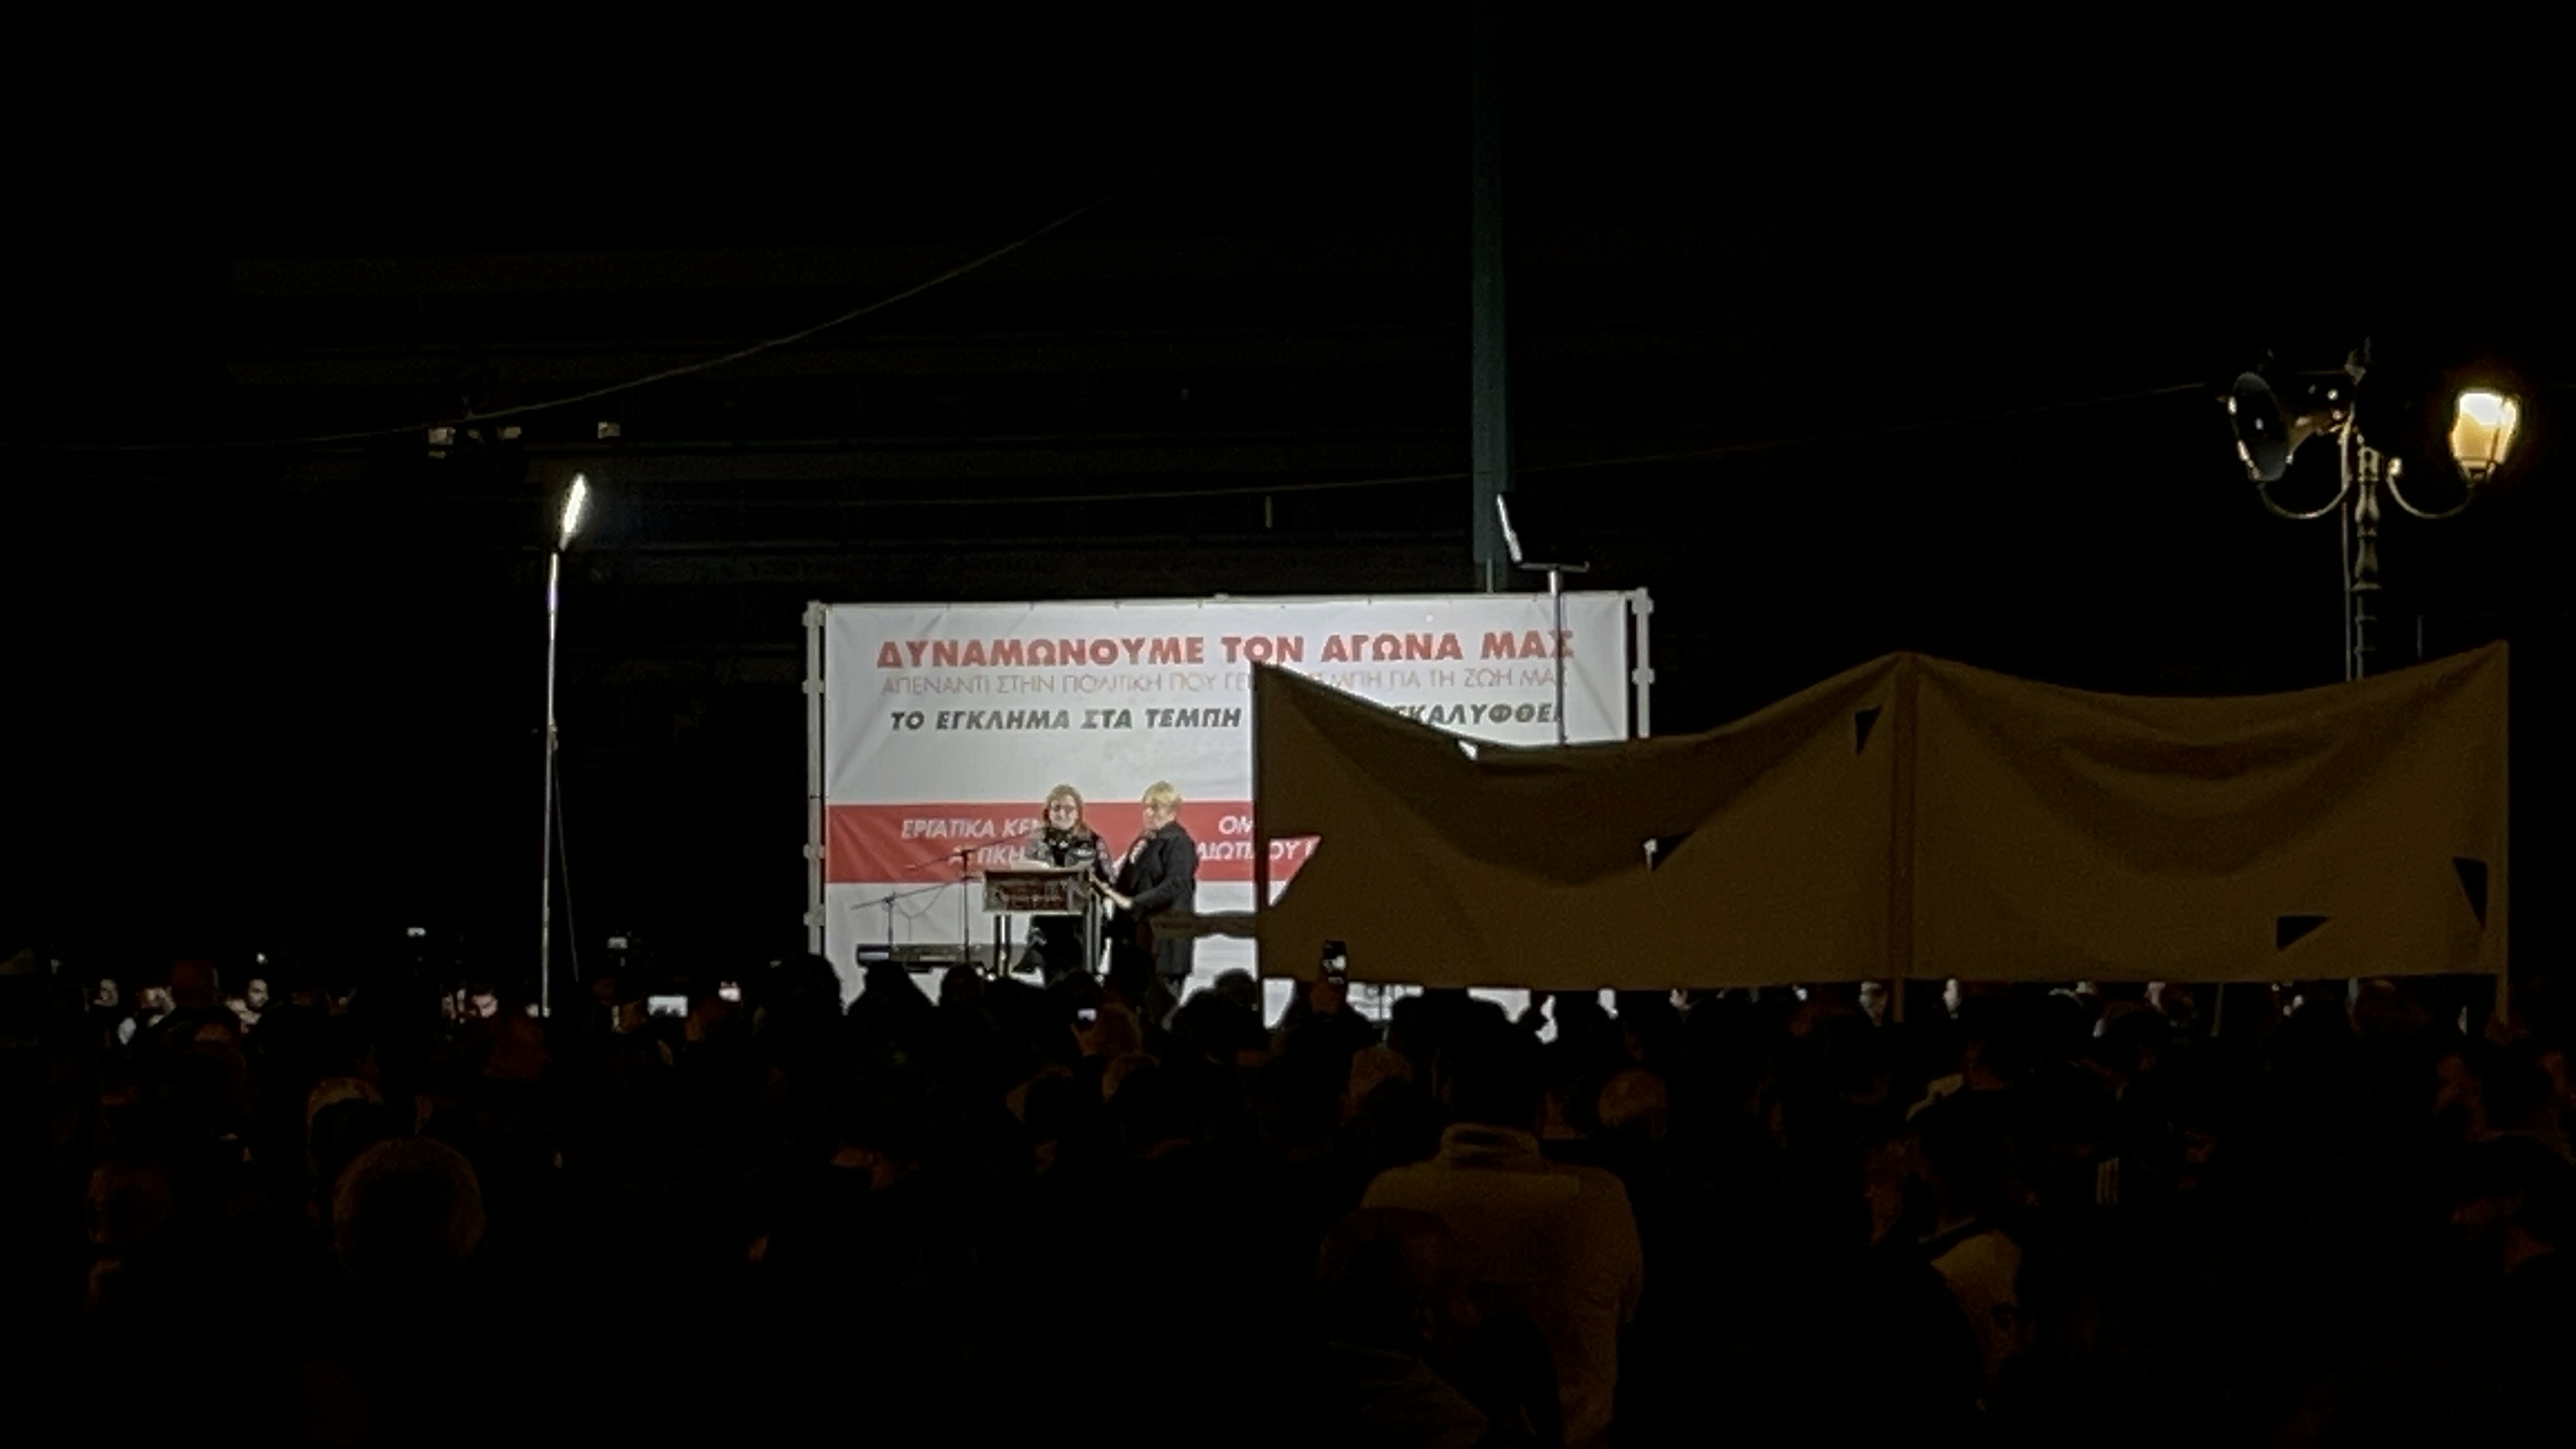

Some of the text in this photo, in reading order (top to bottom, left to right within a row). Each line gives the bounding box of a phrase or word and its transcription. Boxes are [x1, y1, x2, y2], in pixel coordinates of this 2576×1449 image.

[877, 630, 1573, 669] ΔΥΝΑΜΩΝΟΥΜΕ ΤΟΝ ΑΓΩΝΑ ΜΑΣ
[882, 675, 990, 695] ΑΠΕΝΑΝΤΙ
[997, 674, 1055, 694] ΣΤΗΝ
[1063, 672, 1162, 693] ΠΟΛΙΤΙΚΗ
[1171, 671, 1216, 692] ΠΟΥ
[1390, 669, 1421, 689] ΓΙΑ
[1429, 669, 1456, 688] ΤΗ
[1464, 667, 1513, 688] ΖΩΗ
[891, 711, 925, 730] ΤΟ
[936, 709, 1070, 730] ΕΓΚΛΗΜΑ
[1080, 708, 1133, 730] ΣΤΑ
[1146, 707, 1242, 728] ΤΕΜΠΗ
[902, 818, 996, 839] ΕΡΓΑΤΙΚΑ
